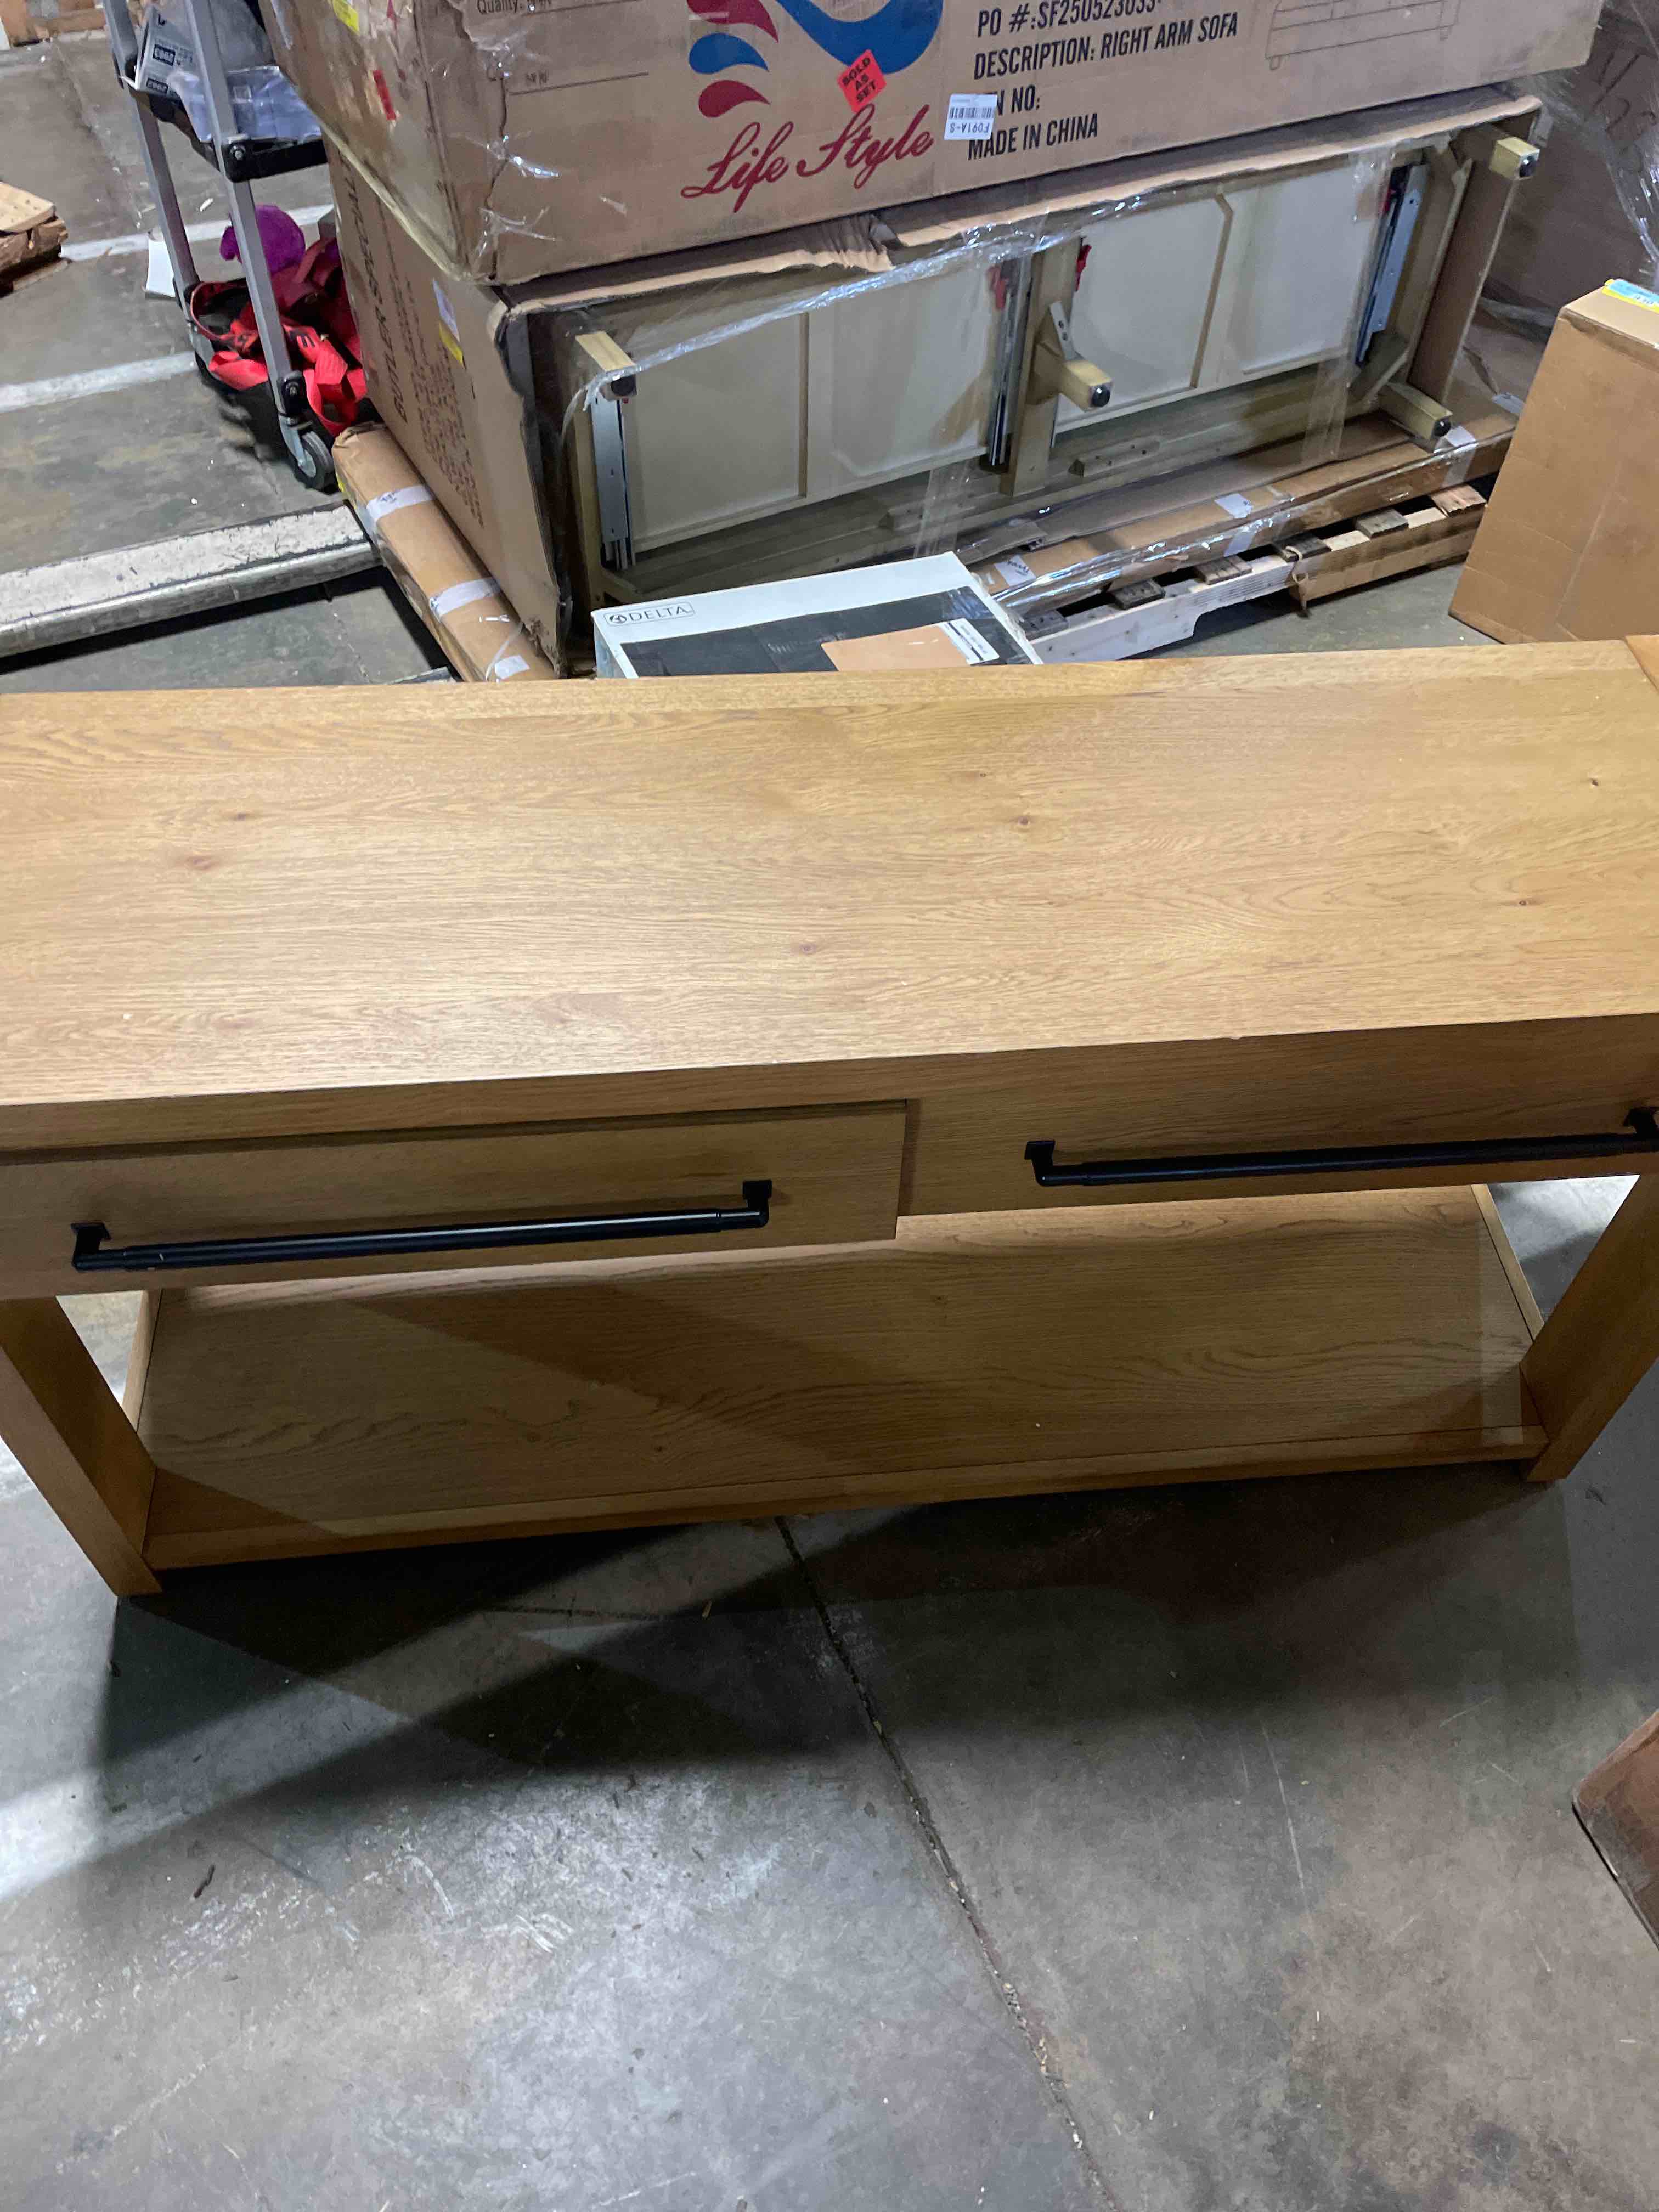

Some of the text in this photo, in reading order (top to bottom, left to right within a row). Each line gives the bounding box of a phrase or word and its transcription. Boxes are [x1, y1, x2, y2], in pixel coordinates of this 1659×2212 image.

[978, 8, 1001, 38] PO
[974, 12, 1238, 80] DESCRIPTION: RIGHT ARM SOFA
[842, 57, 871, 87] SOLD
[856, 73, 870, 91] AS
[856, 80, 876, 103] SET
[1011, 84, 1040, 113] NO:
[968, 112, 1098, 161] MADE IN CHINA
[680, 104, 933, 213] Life Style
[336, 144, 383, 305] SPECIALT
[374, 304, 409, 425] BUTLER
[628, 606, 690, 622] DELTA
